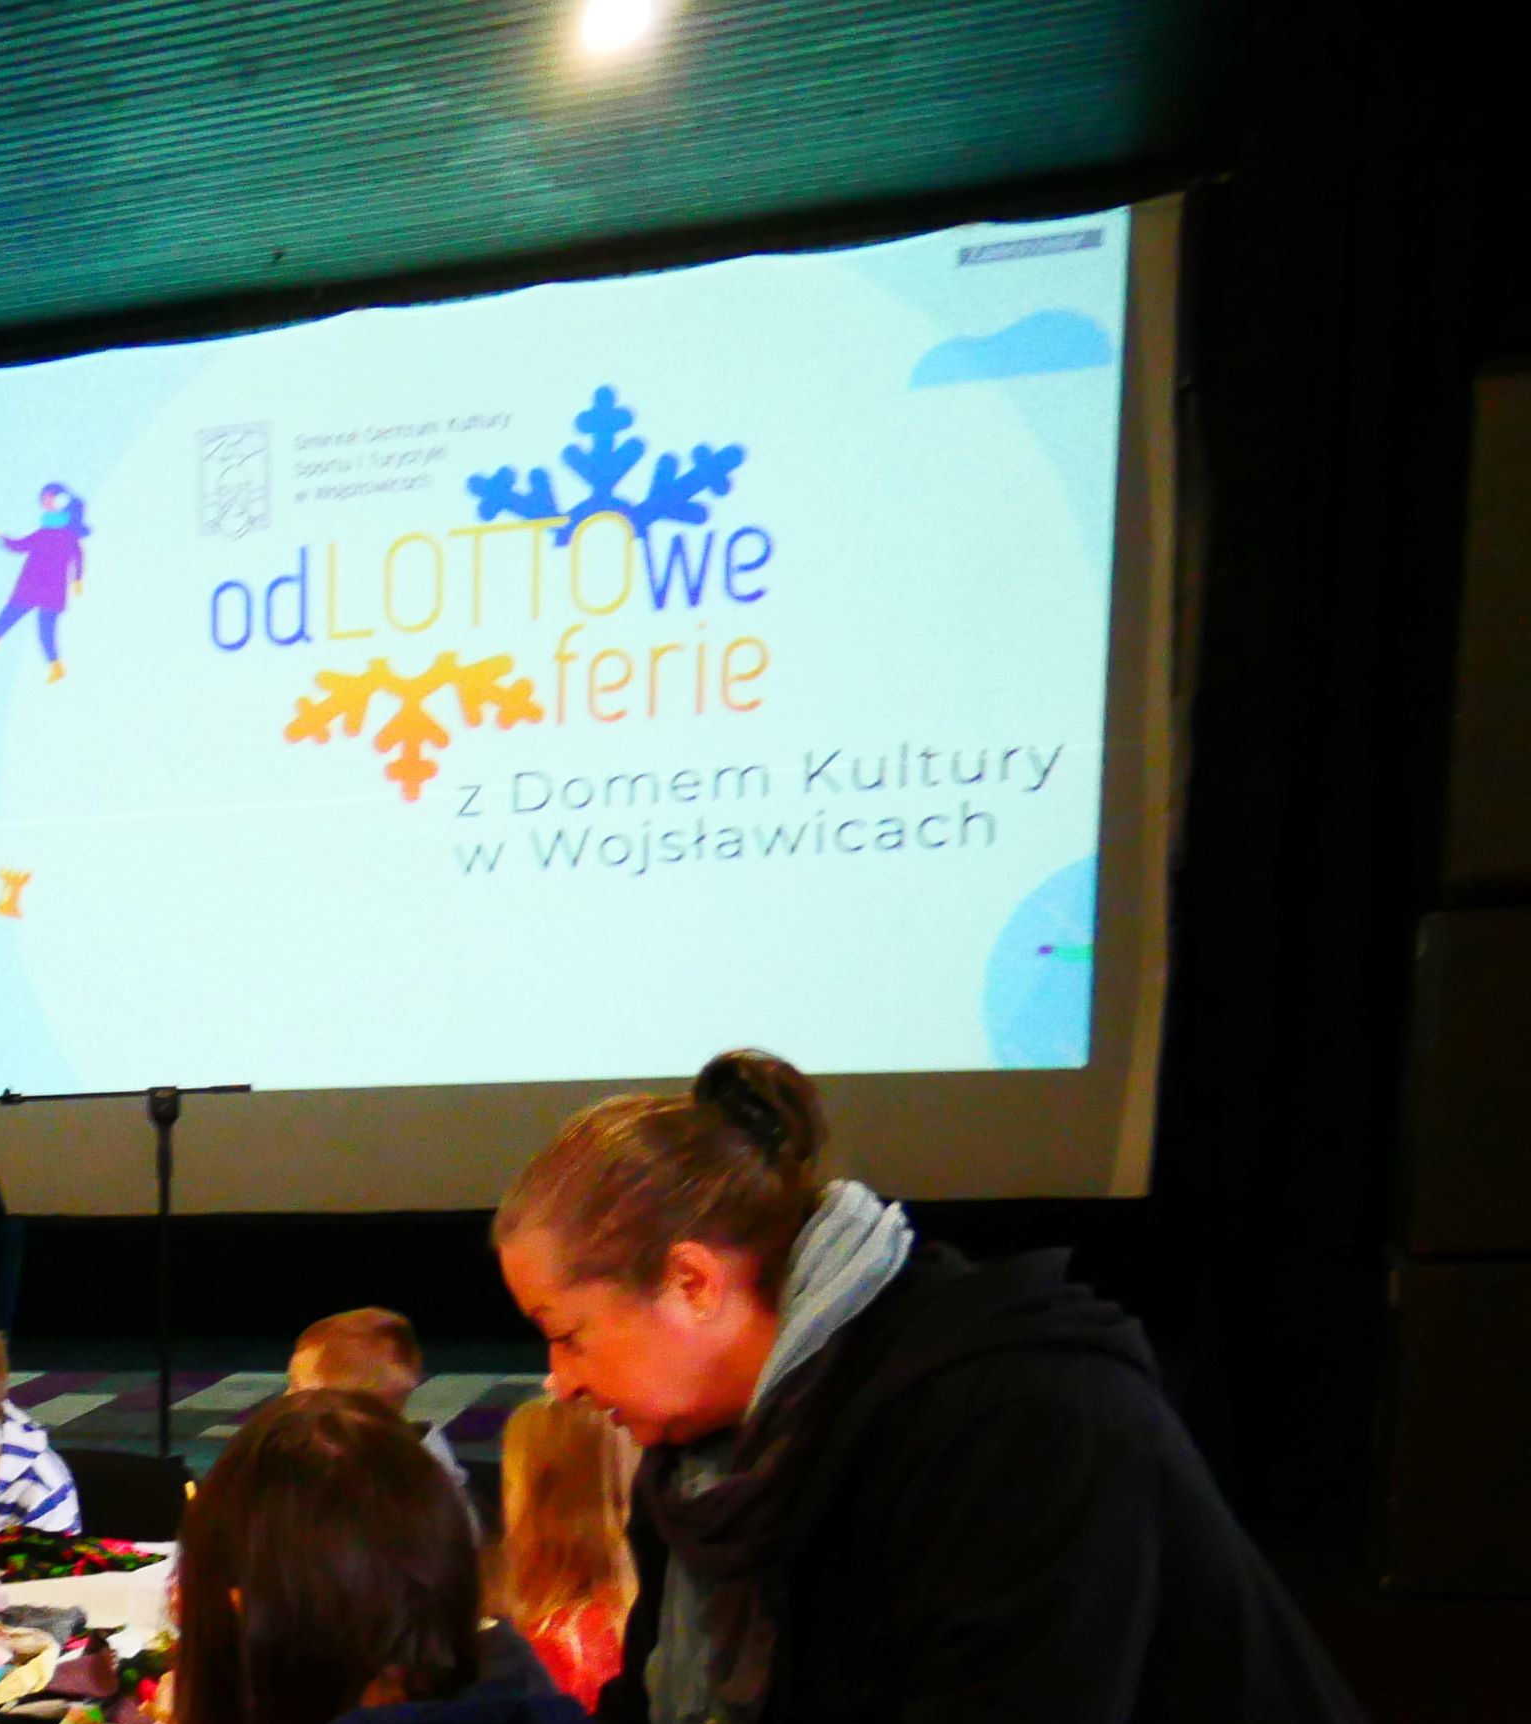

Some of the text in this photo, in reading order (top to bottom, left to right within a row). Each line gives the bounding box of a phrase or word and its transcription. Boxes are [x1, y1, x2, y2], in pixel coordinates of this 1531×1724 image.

[211, 510, 773, 652] odLOTTOwe
[554, 622, 771, 725] ferie
[455, 741, 1065, 818] z Domem Kultury
[454, 799, 996, 877] w Wojsławicach
